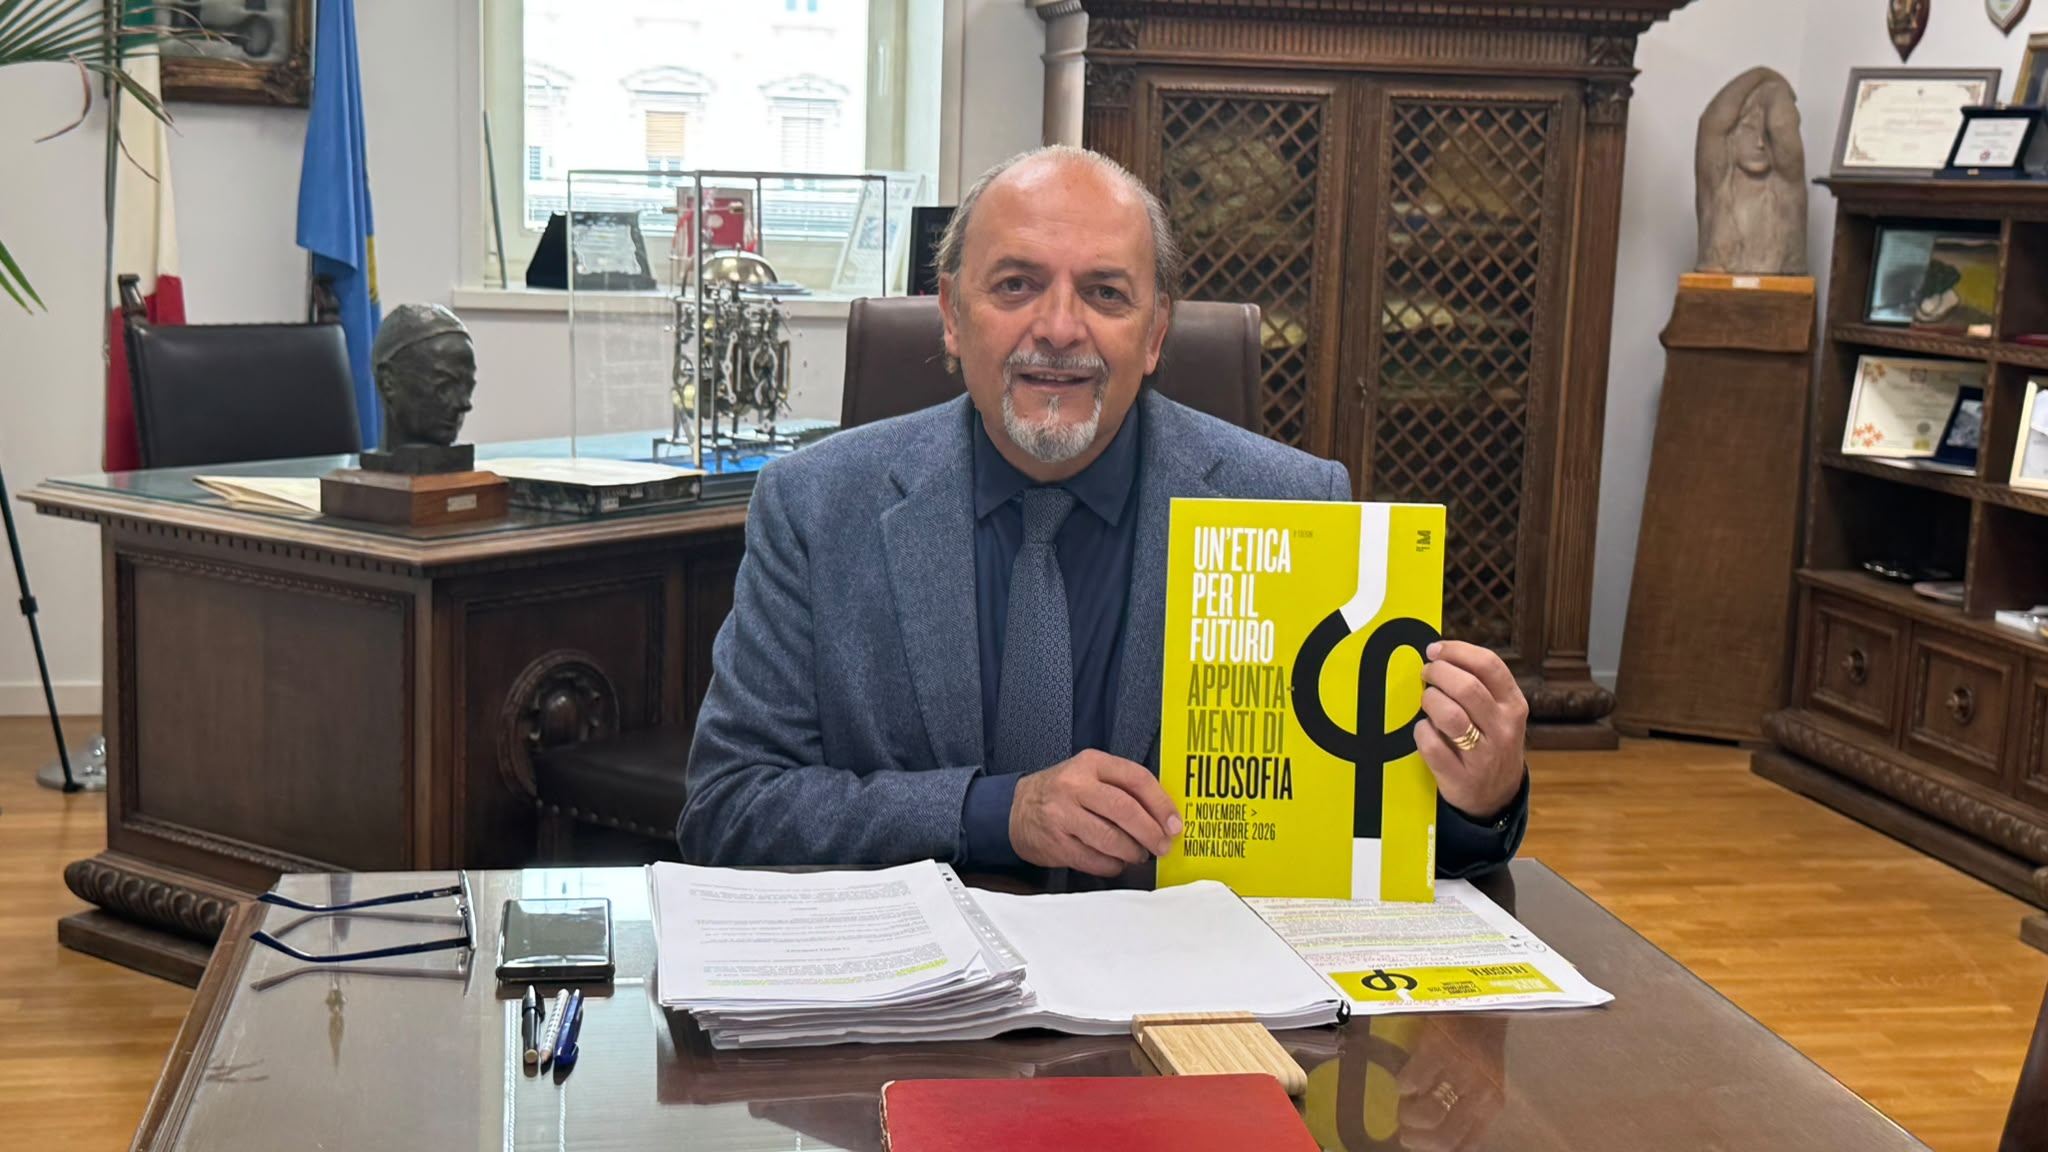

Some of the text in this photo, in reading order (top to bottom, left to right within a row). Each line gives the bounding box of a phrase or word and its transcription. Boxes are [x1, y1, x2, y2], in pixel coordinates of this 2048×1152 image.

[1194, 526, 1291, 573] UN'ETICA
[1192, 572, 1259, 618] PER IL
[1190, 619, 1275, 664] FUTURO
[1187, 710, 1284, 754] MENTI DI
[1185, 755, 1293, 800] FILOSOFIA
[1184, 821, 1276, 841] 22 NOVEMBRE 2026
[1195, 802, 1247, 821] NOVEMBRE
[1184, 839, 1246, 859] MONFALCONE
